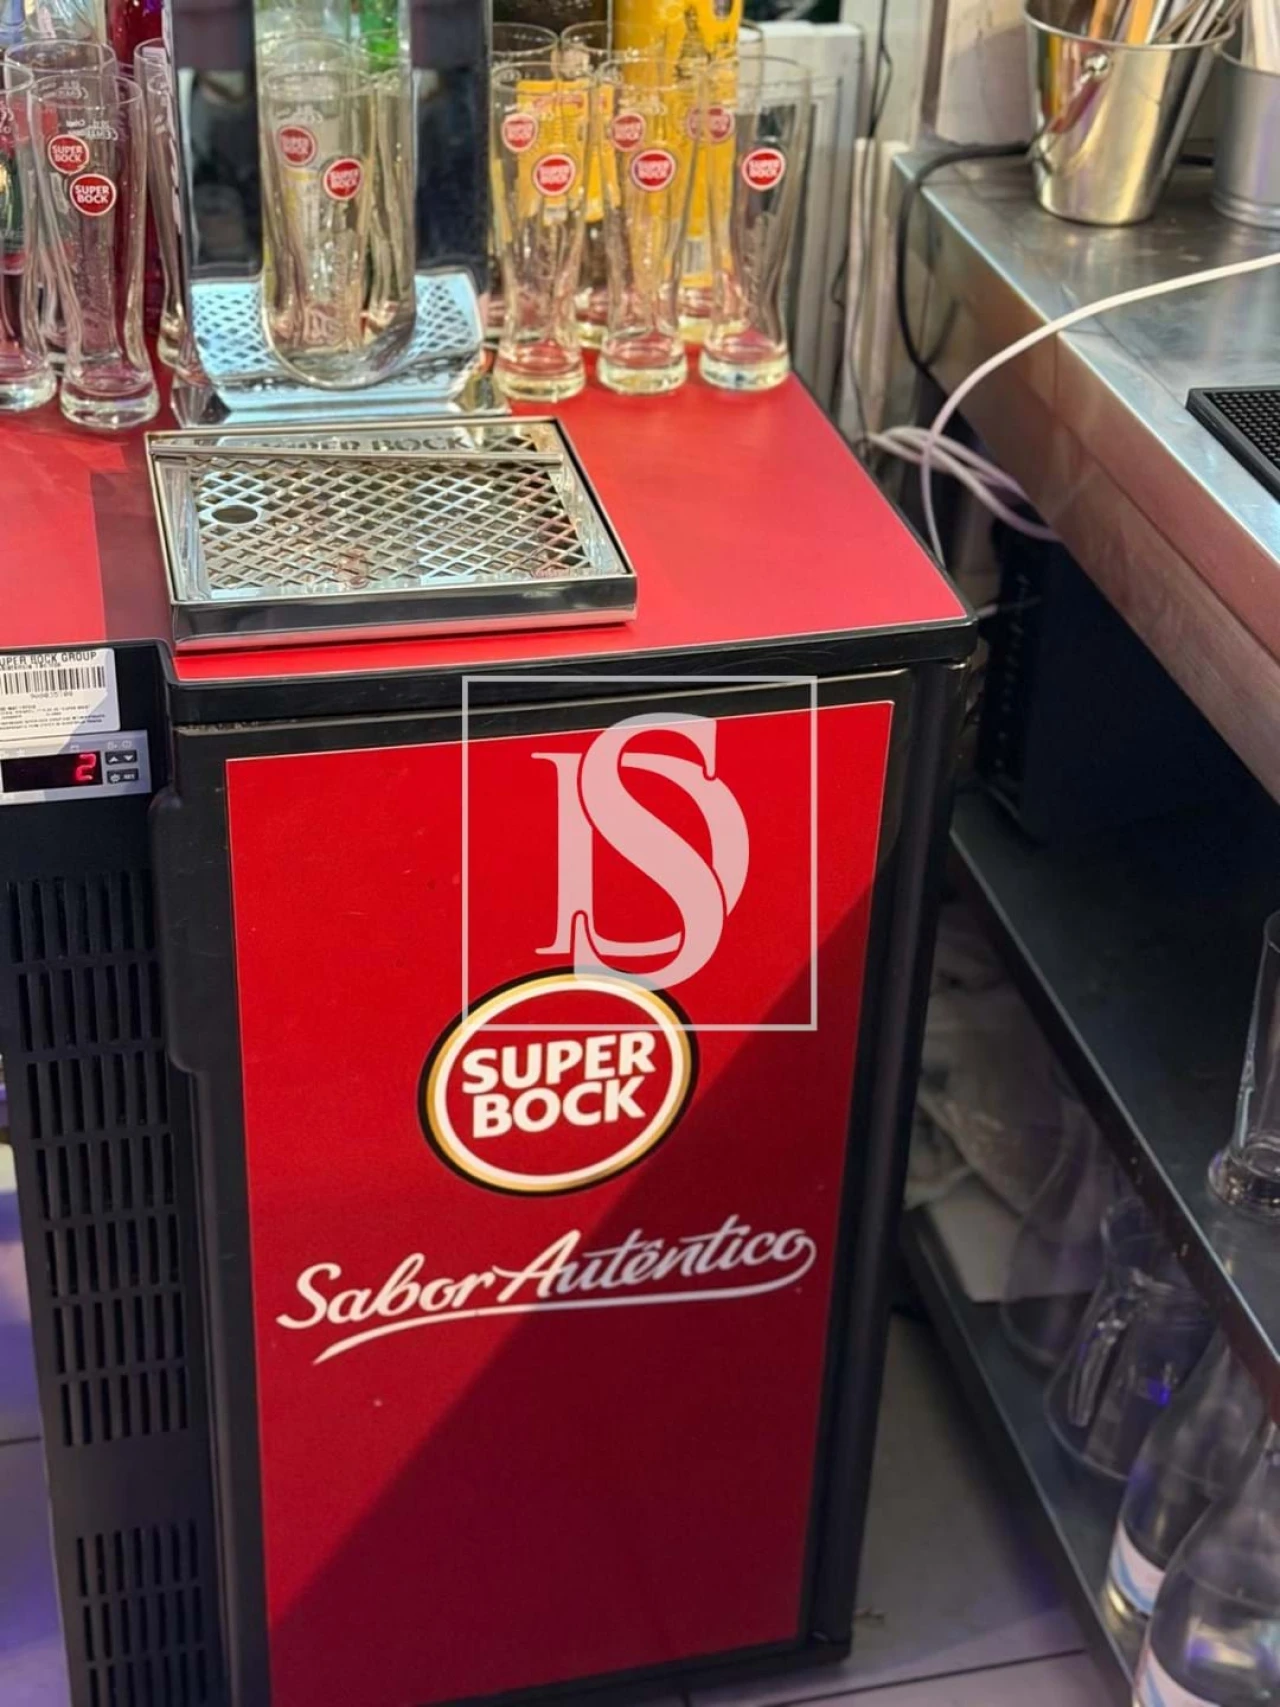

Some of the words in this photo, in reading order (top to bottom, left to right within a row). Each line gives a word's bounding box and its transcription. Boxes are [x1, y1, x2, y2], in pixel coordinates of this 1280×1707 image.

[51, 145, 83, 154] SUPER
[54, 153, 82, 163] BOCK
[74, 184, 110, 195] SUPER
[76, 194, 109, 204] BOCK
[0, 656, 27, 666] UPER
[61, 651, 97, 662] GROUP
[75, 752, 97, 782] 2
[461, 1031, 656, 1094] SUPER
[473, 1075, 647, 1139] BOCK
[276, 1252, 497, 1330] Sabor
[494, 1213, 817, 1304] Autêntico
